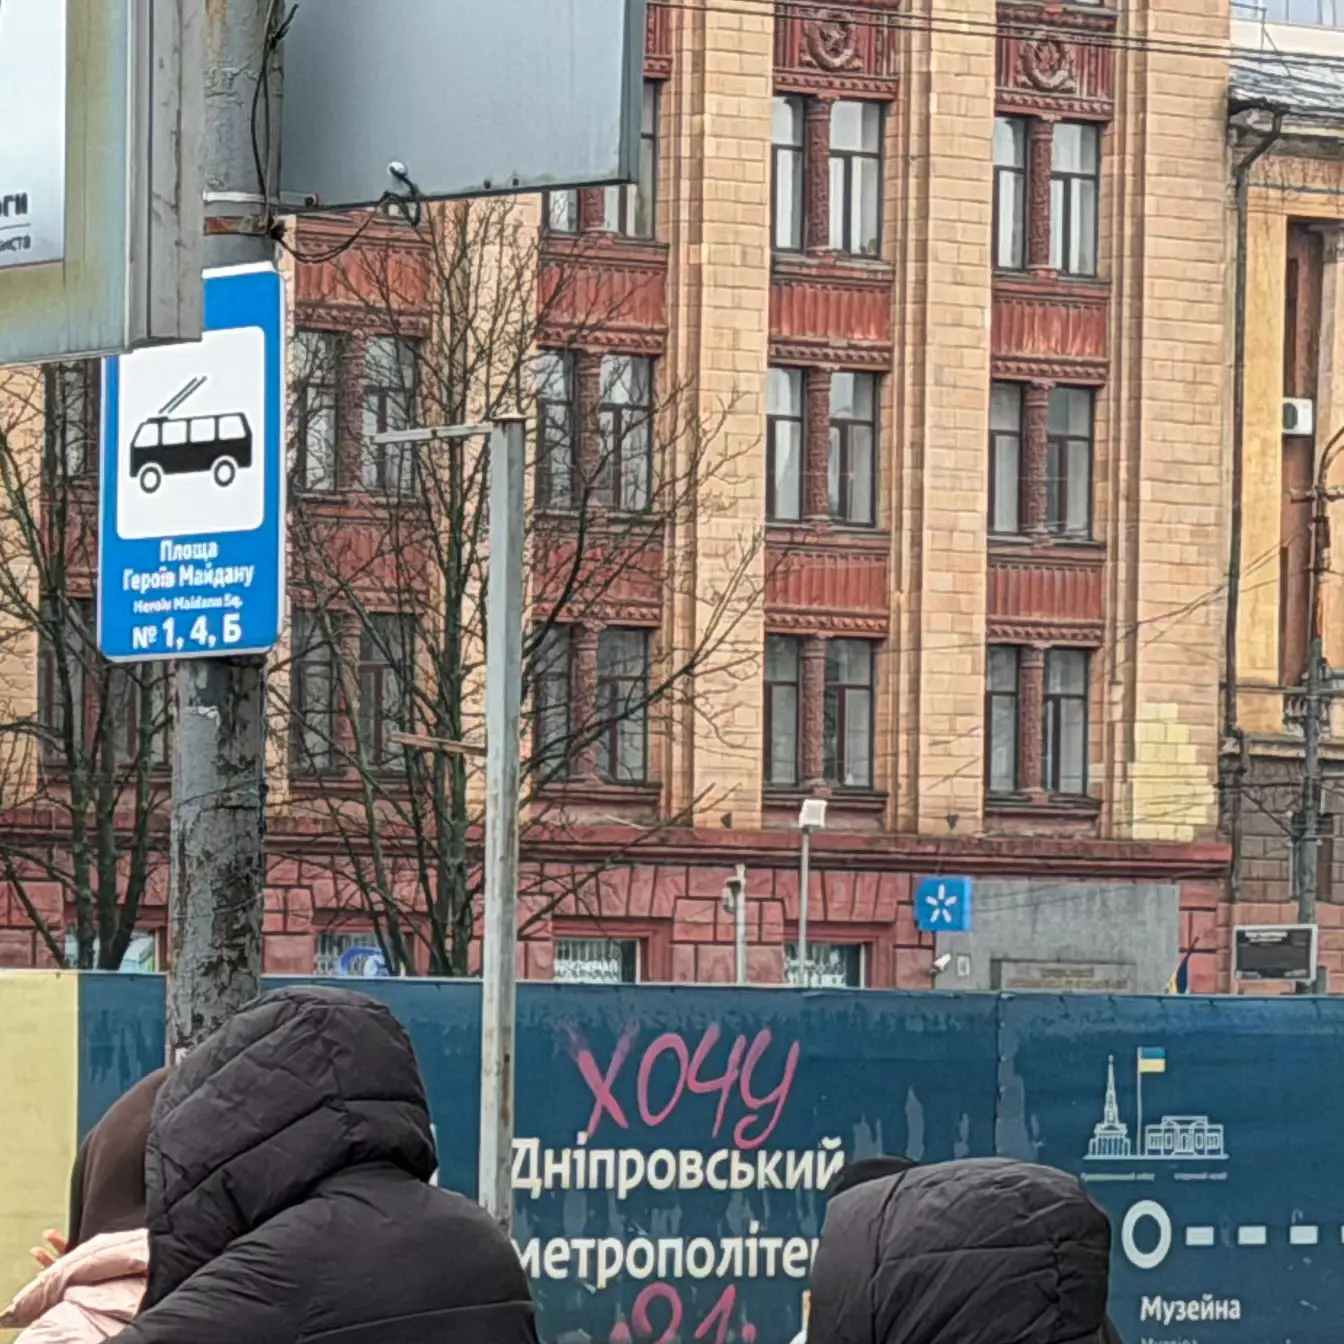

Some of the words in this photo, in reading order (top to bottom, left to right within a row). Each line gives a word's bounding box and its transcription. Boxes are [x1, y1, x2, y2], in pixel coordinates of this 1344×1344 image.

[160, 540, 218, 561] Площа
[123, 566, 175, 594] Героїв
[179, 562, 254, 588] Майдану
[162, 617, 184, 650] 1,
[190, 615, 216, 648] 4,
[223, 612, 242, 643] Б
[512, 1132, 845, 1199] Дніпровський
[512, 1221, 819, 1289] метрополіте
[1140, 1294, 1241, 1325] Музейна
